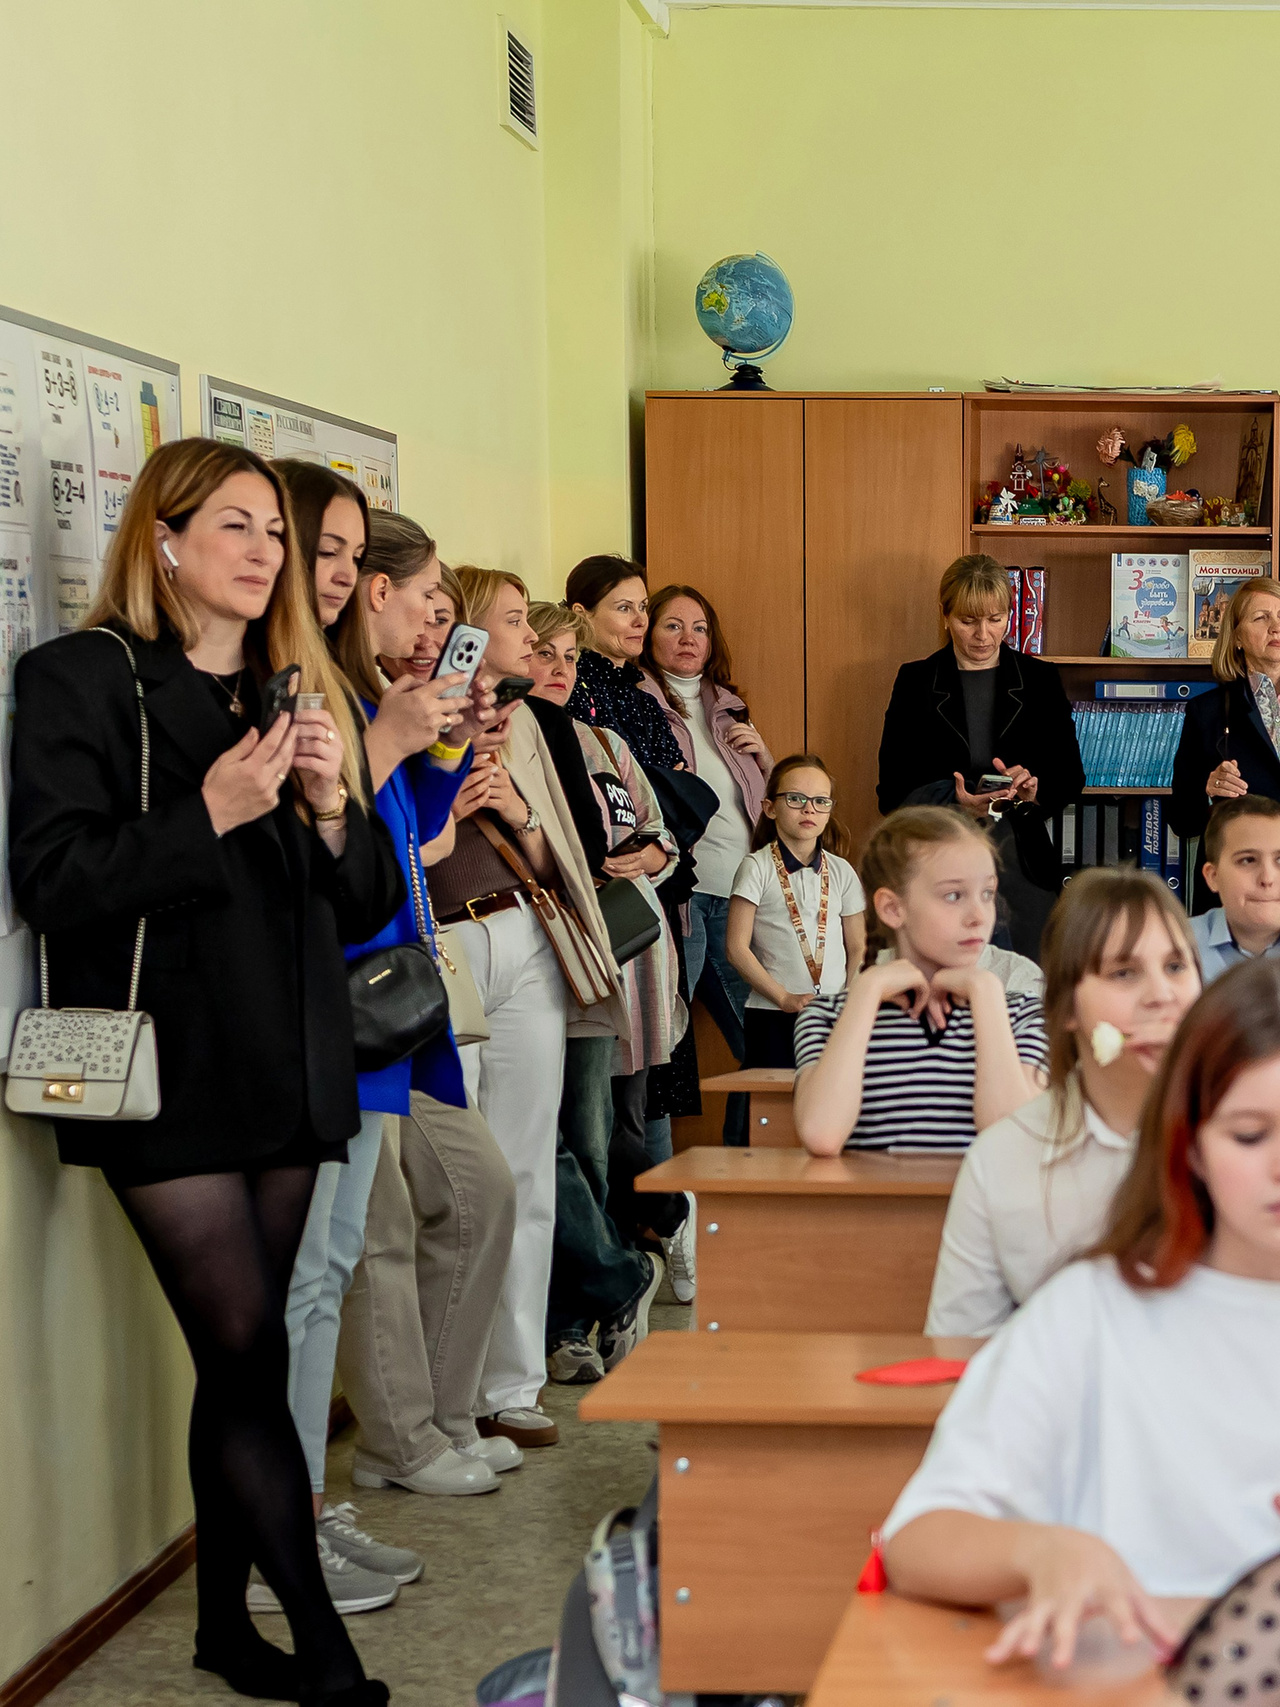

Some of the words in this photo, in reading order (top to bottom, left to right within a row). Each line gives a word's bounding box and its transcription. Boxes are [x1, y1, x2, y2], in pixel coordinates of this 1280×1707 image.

[1199, 566, 1220, 575] Моя
[1221, 567, 1260, 576] столица
[1144, 812, 1153, 854] ДРЕВО
